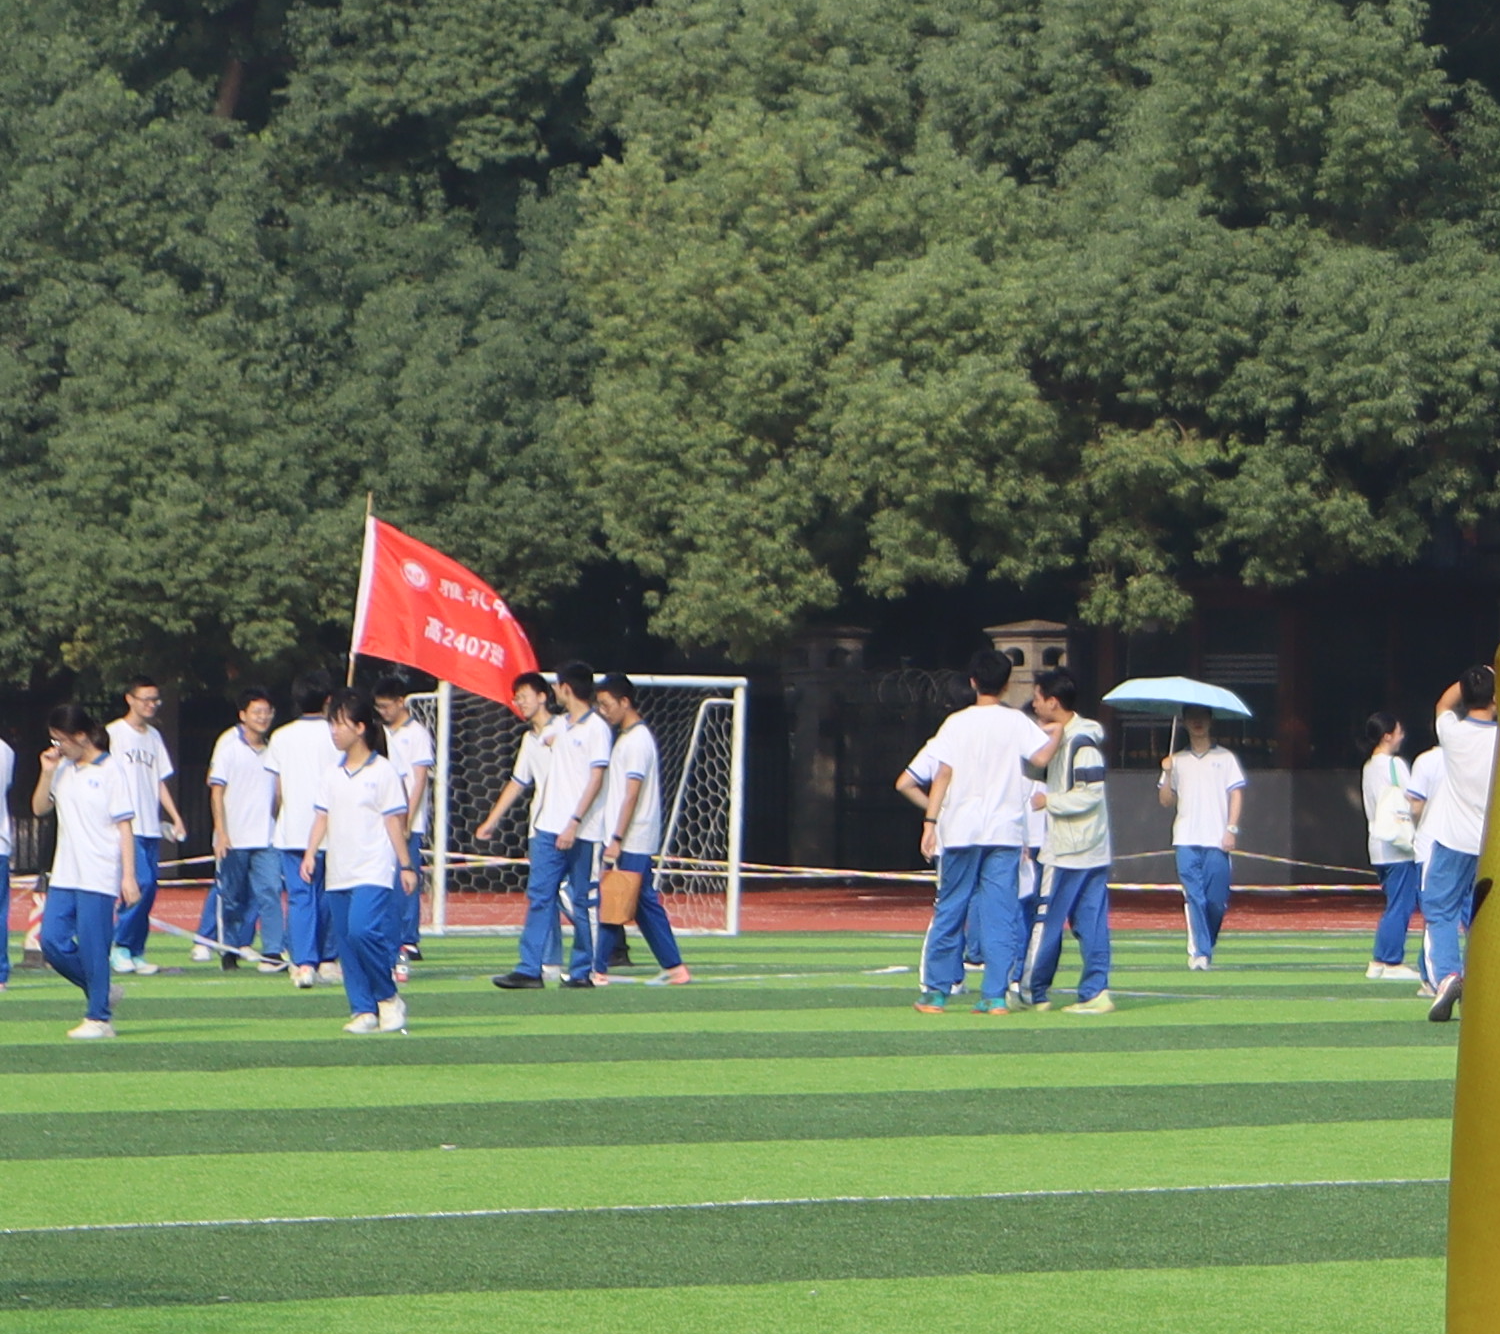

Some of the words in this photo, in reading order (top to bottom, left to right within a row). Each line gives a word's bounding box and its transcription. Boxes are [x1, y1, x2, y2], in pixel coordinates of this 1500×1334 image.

[438, 578, 524, 637] 雅礼中
[424, 616, 505, 668] 高2407班
